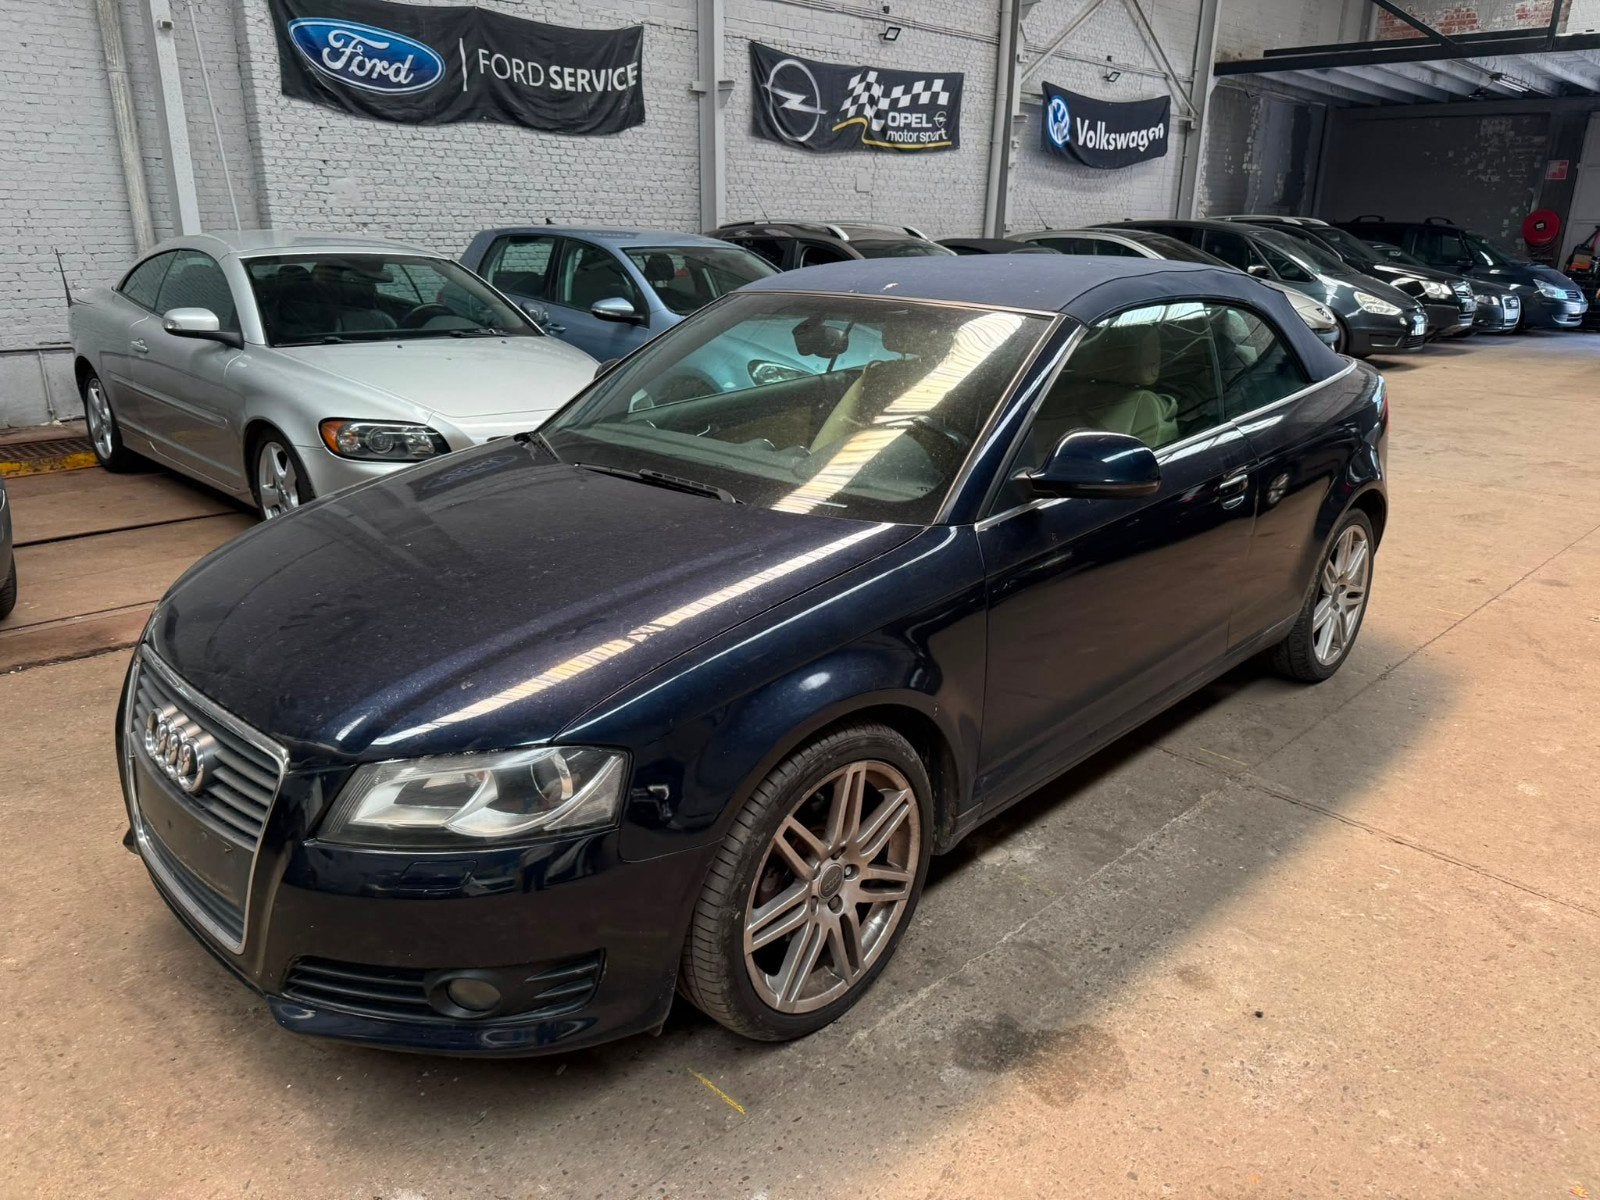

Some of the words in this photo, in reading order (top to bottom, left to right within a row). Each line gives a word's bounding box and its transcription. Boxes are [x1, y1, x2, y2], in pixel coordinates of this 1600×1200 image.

[322, 30, 414, 85] Ford
[478, 48, 545, 88] FORD
[549, 62, 638, 93] SERVICE
[887, 112, 932, 127] OPEL
[1076, 117, 1164, 152] Volkswagen
